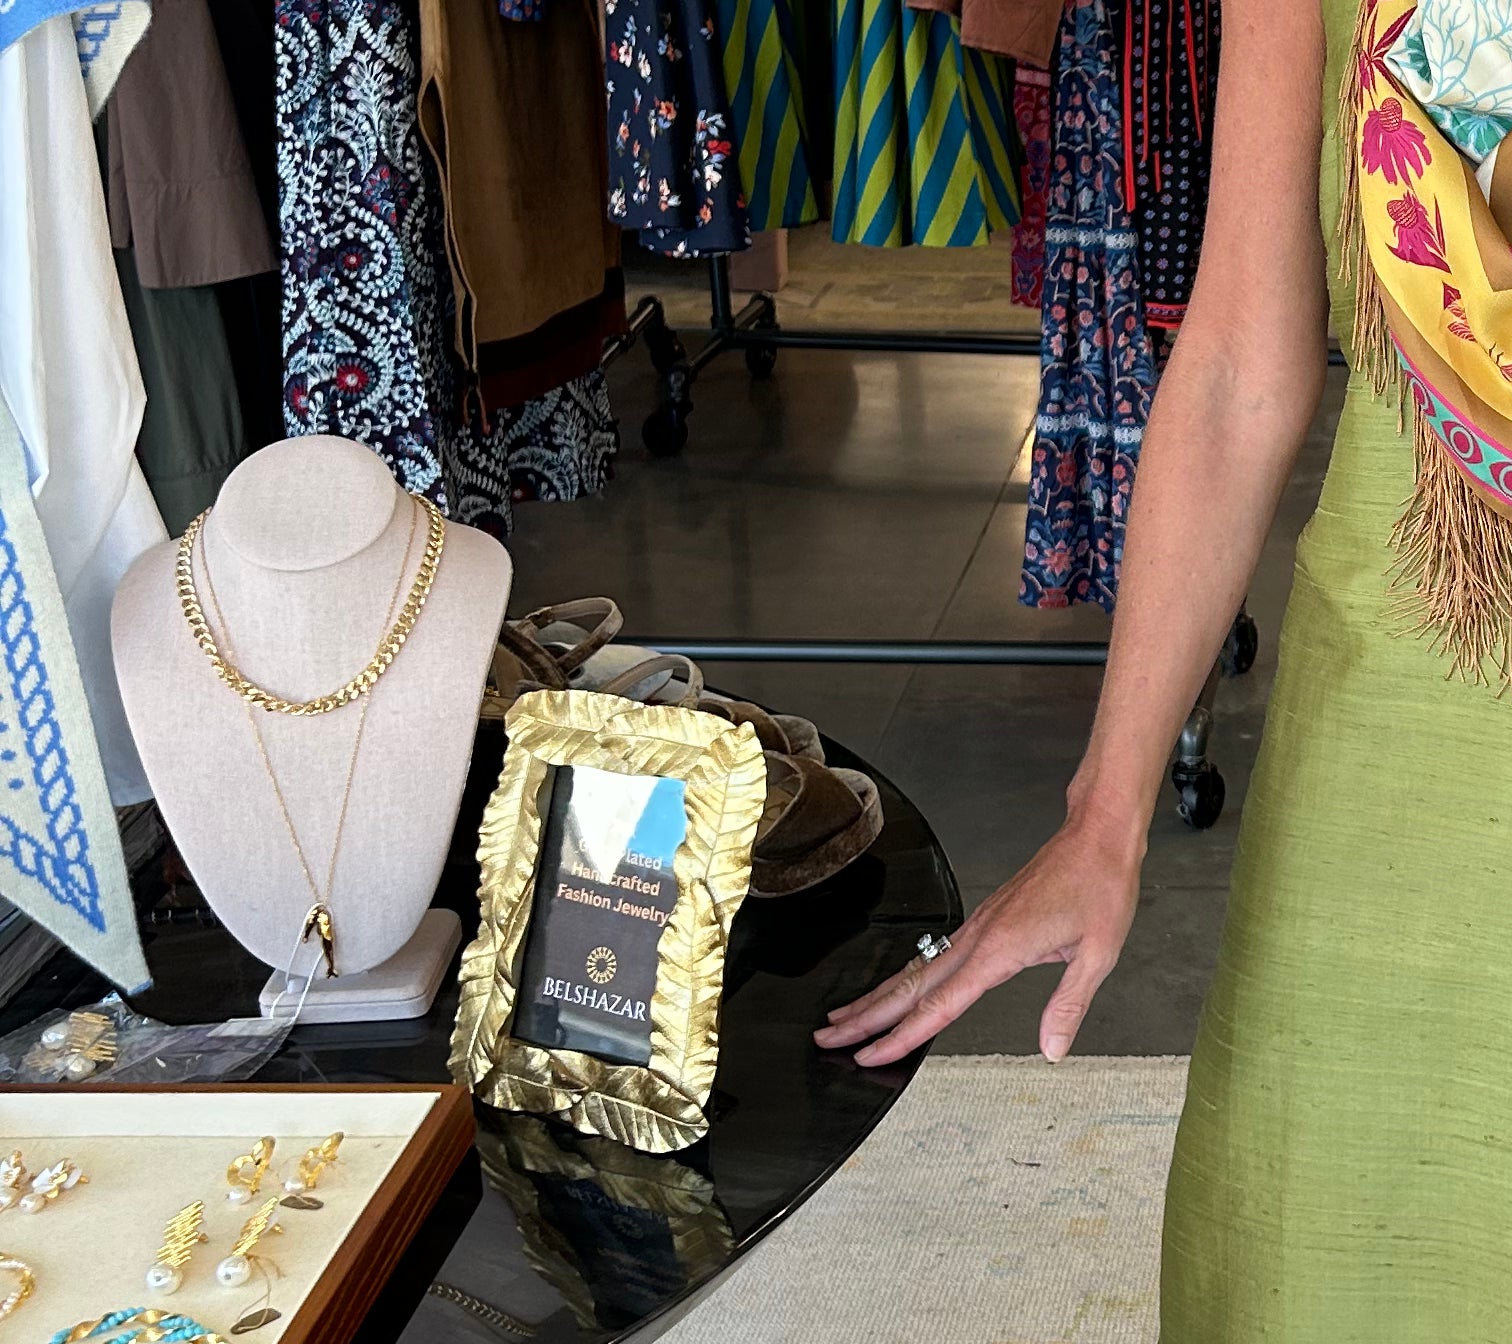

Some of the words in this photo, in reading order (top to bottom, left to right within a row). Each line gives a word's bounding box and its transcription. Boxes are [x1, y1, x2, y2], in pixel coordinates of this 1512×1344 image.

[571, 859, 661, 896] Hancrafted
[618, 847, 663, 871] lated
[557, 883, 611, 910] Fashion
[613, 897, 670, 928] Jewelry
[542, 976, 647, 1022] BELSHAZAR
